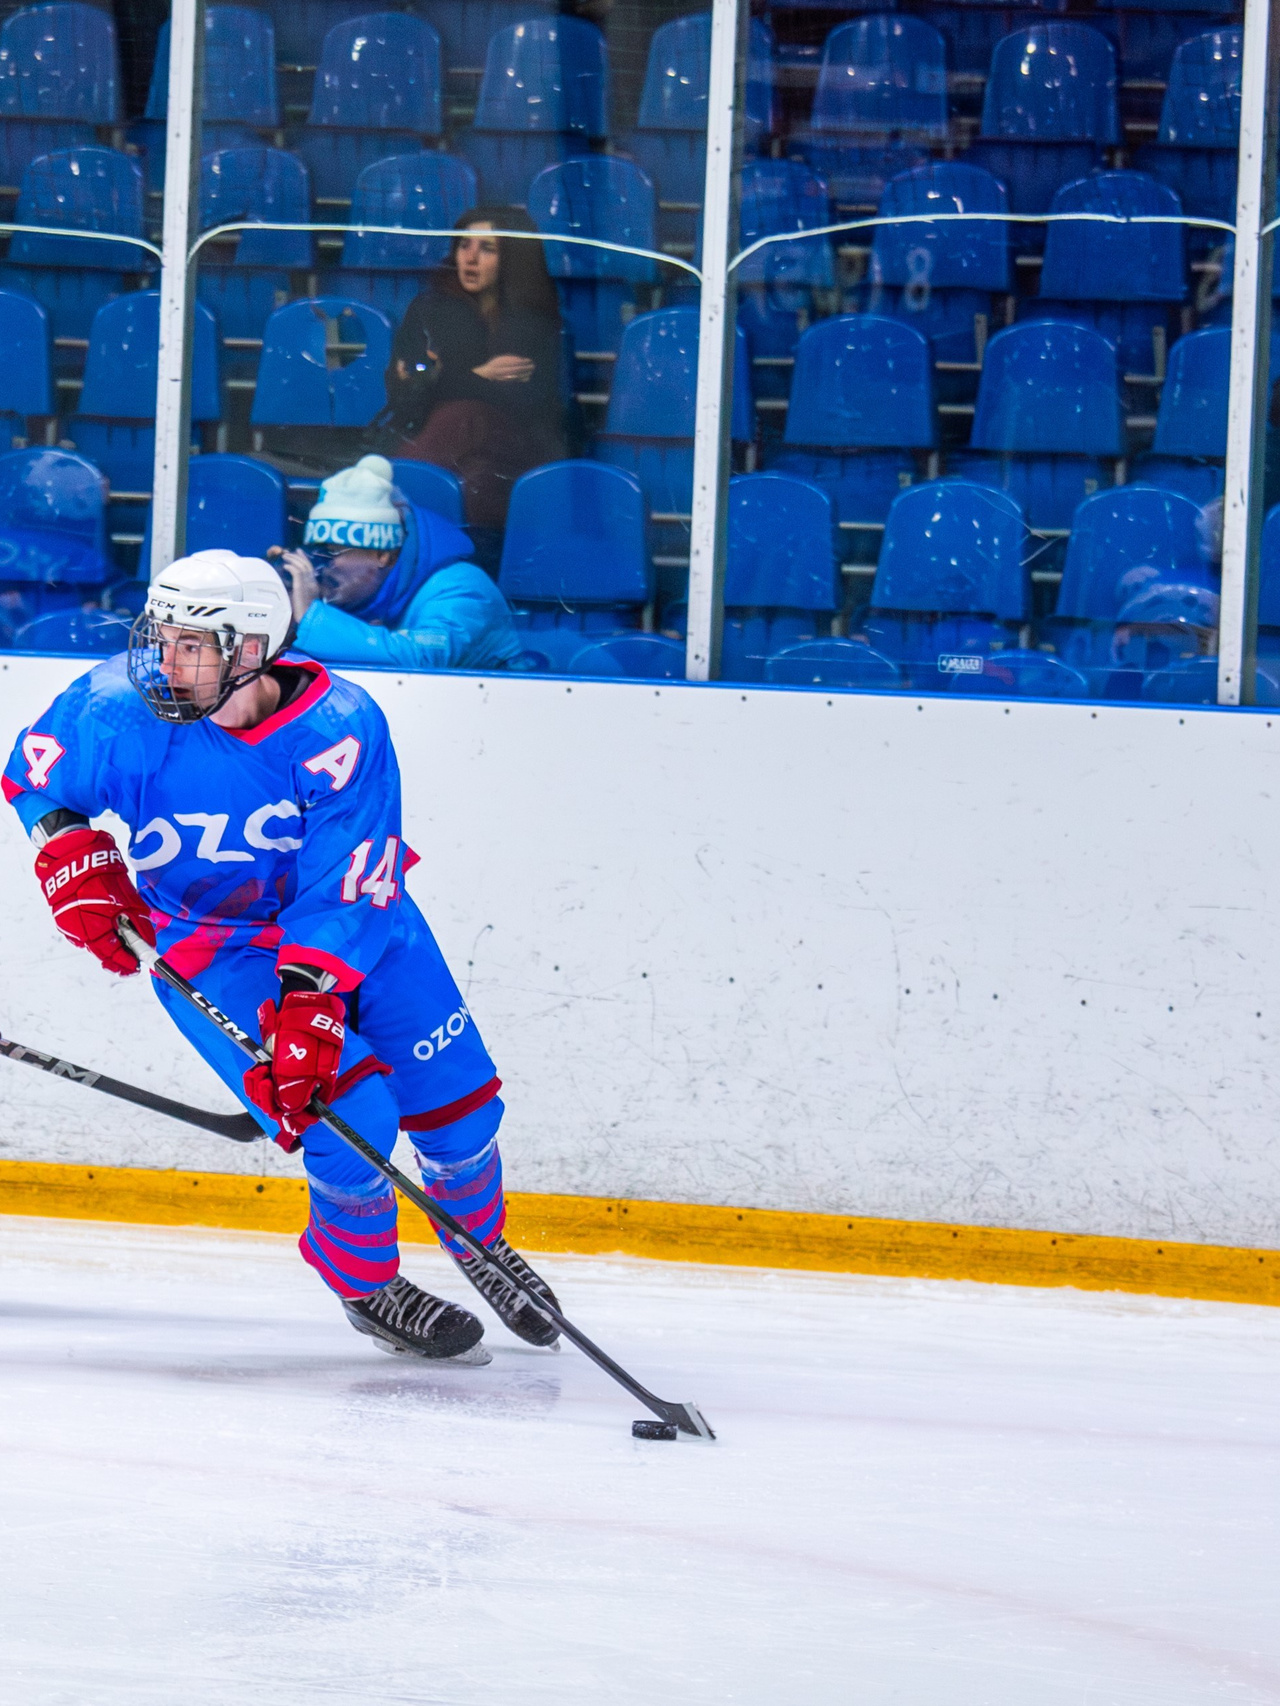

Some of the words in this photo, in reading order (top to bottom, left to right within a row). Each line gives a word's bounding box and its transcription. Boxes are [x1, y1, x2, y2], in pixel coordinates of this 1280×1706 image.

[150, 598, 176, 610] CCM
[22, 731, 67, 790] 4
[301, 734, 362, 792] A
[340, 834, 401, 910] 14
[191, 991, 249, 1041] CCM
